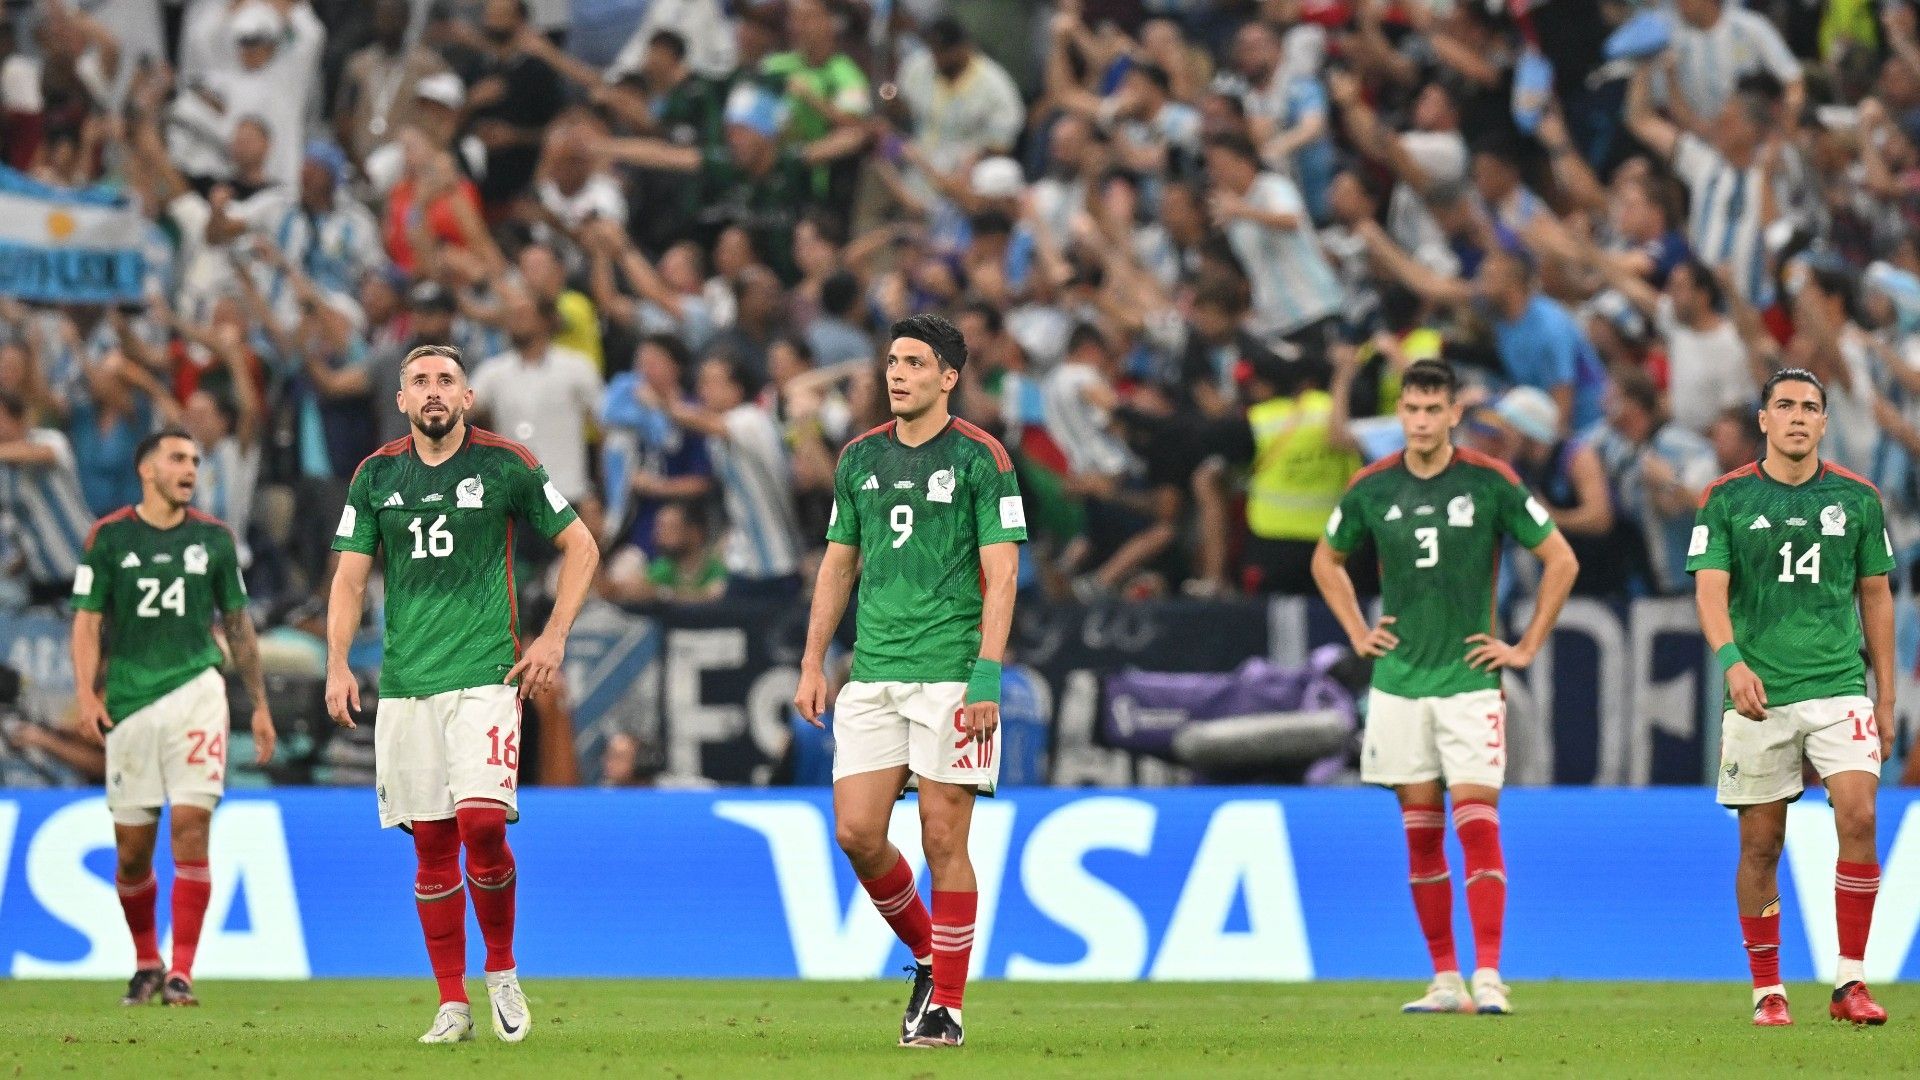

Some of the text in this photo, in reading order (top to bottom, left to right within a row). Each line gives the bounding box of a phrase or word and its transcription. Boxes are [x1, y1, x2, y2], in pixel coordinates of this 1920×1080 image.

[408, 514, 454, 559] 16
[890, 504, 914, 549] 9
[1414, 527, 1439, 569] 3
[1778, 541, 1821, 584] 14
[136, 576, 186, 618] 24
[186, 729, 226, 766] 24
[486, 725, 518, 771] 16
[1486, 713, 1503, 749] 3
[0, 795, 312, 980] SA
[712, 796, 1317, 981] VISA
